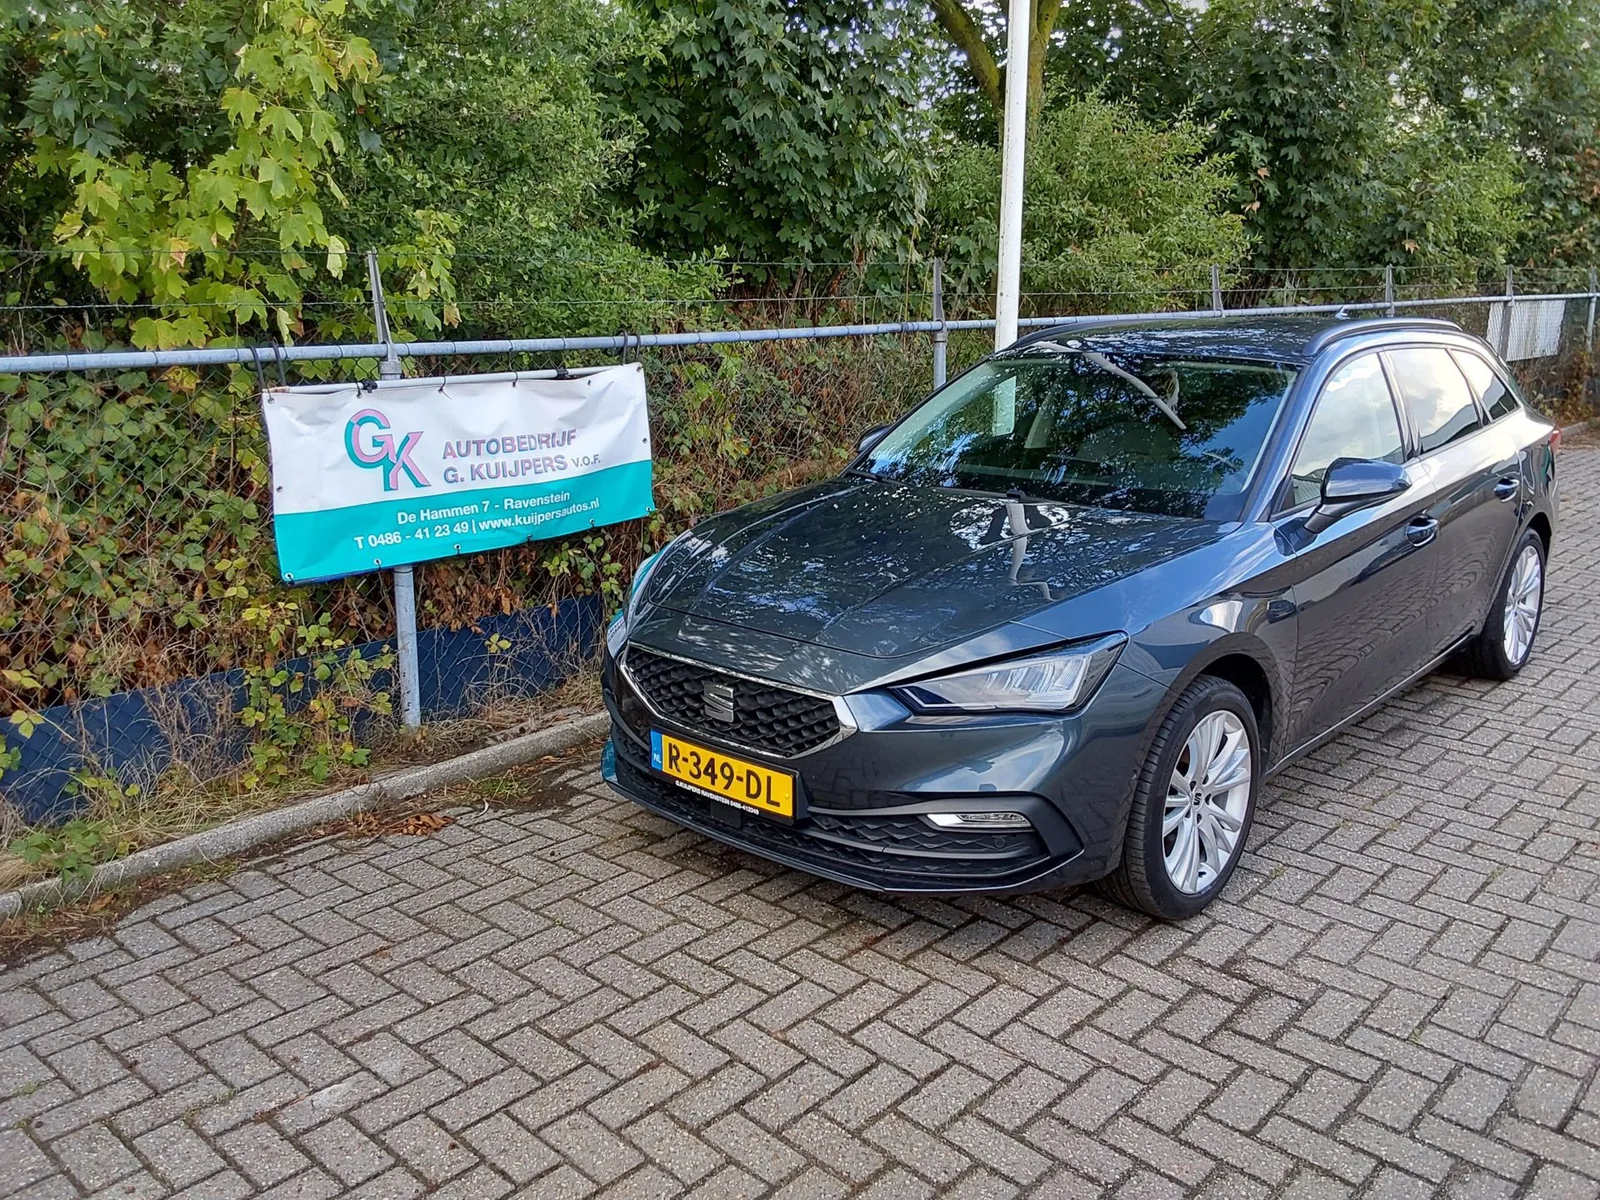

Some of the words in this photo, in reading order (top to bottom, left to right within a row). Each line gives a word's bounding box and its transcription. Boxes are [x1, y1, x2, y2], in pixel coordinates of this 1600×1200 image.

[442, 428, 577, 460] AUTOBEDRIJF
[443, 466, 465, 484] G.
[470, 454, 568, 481] KUIJPERS
[571, 453, 601, 468] V.O.F.
[353, 536, 364, 549] T
[367, 531, 402, 547] 0486
[414, 527, 430, 540] 41
[434, 524, 451, 538] 23
[453, 521, 469, 534] 49
[478, 498, 600, 531] www.kuijpersautos.nl
[397, 511, 417, 525] De
[420, 504, 479, 521] Hammen
[481, 500, 490, 513] 7
[504, 491, 570, 510] Ravenstein
[653, 752, 662, 764] NL
[667, 742, 781, 808] R-349-DL
